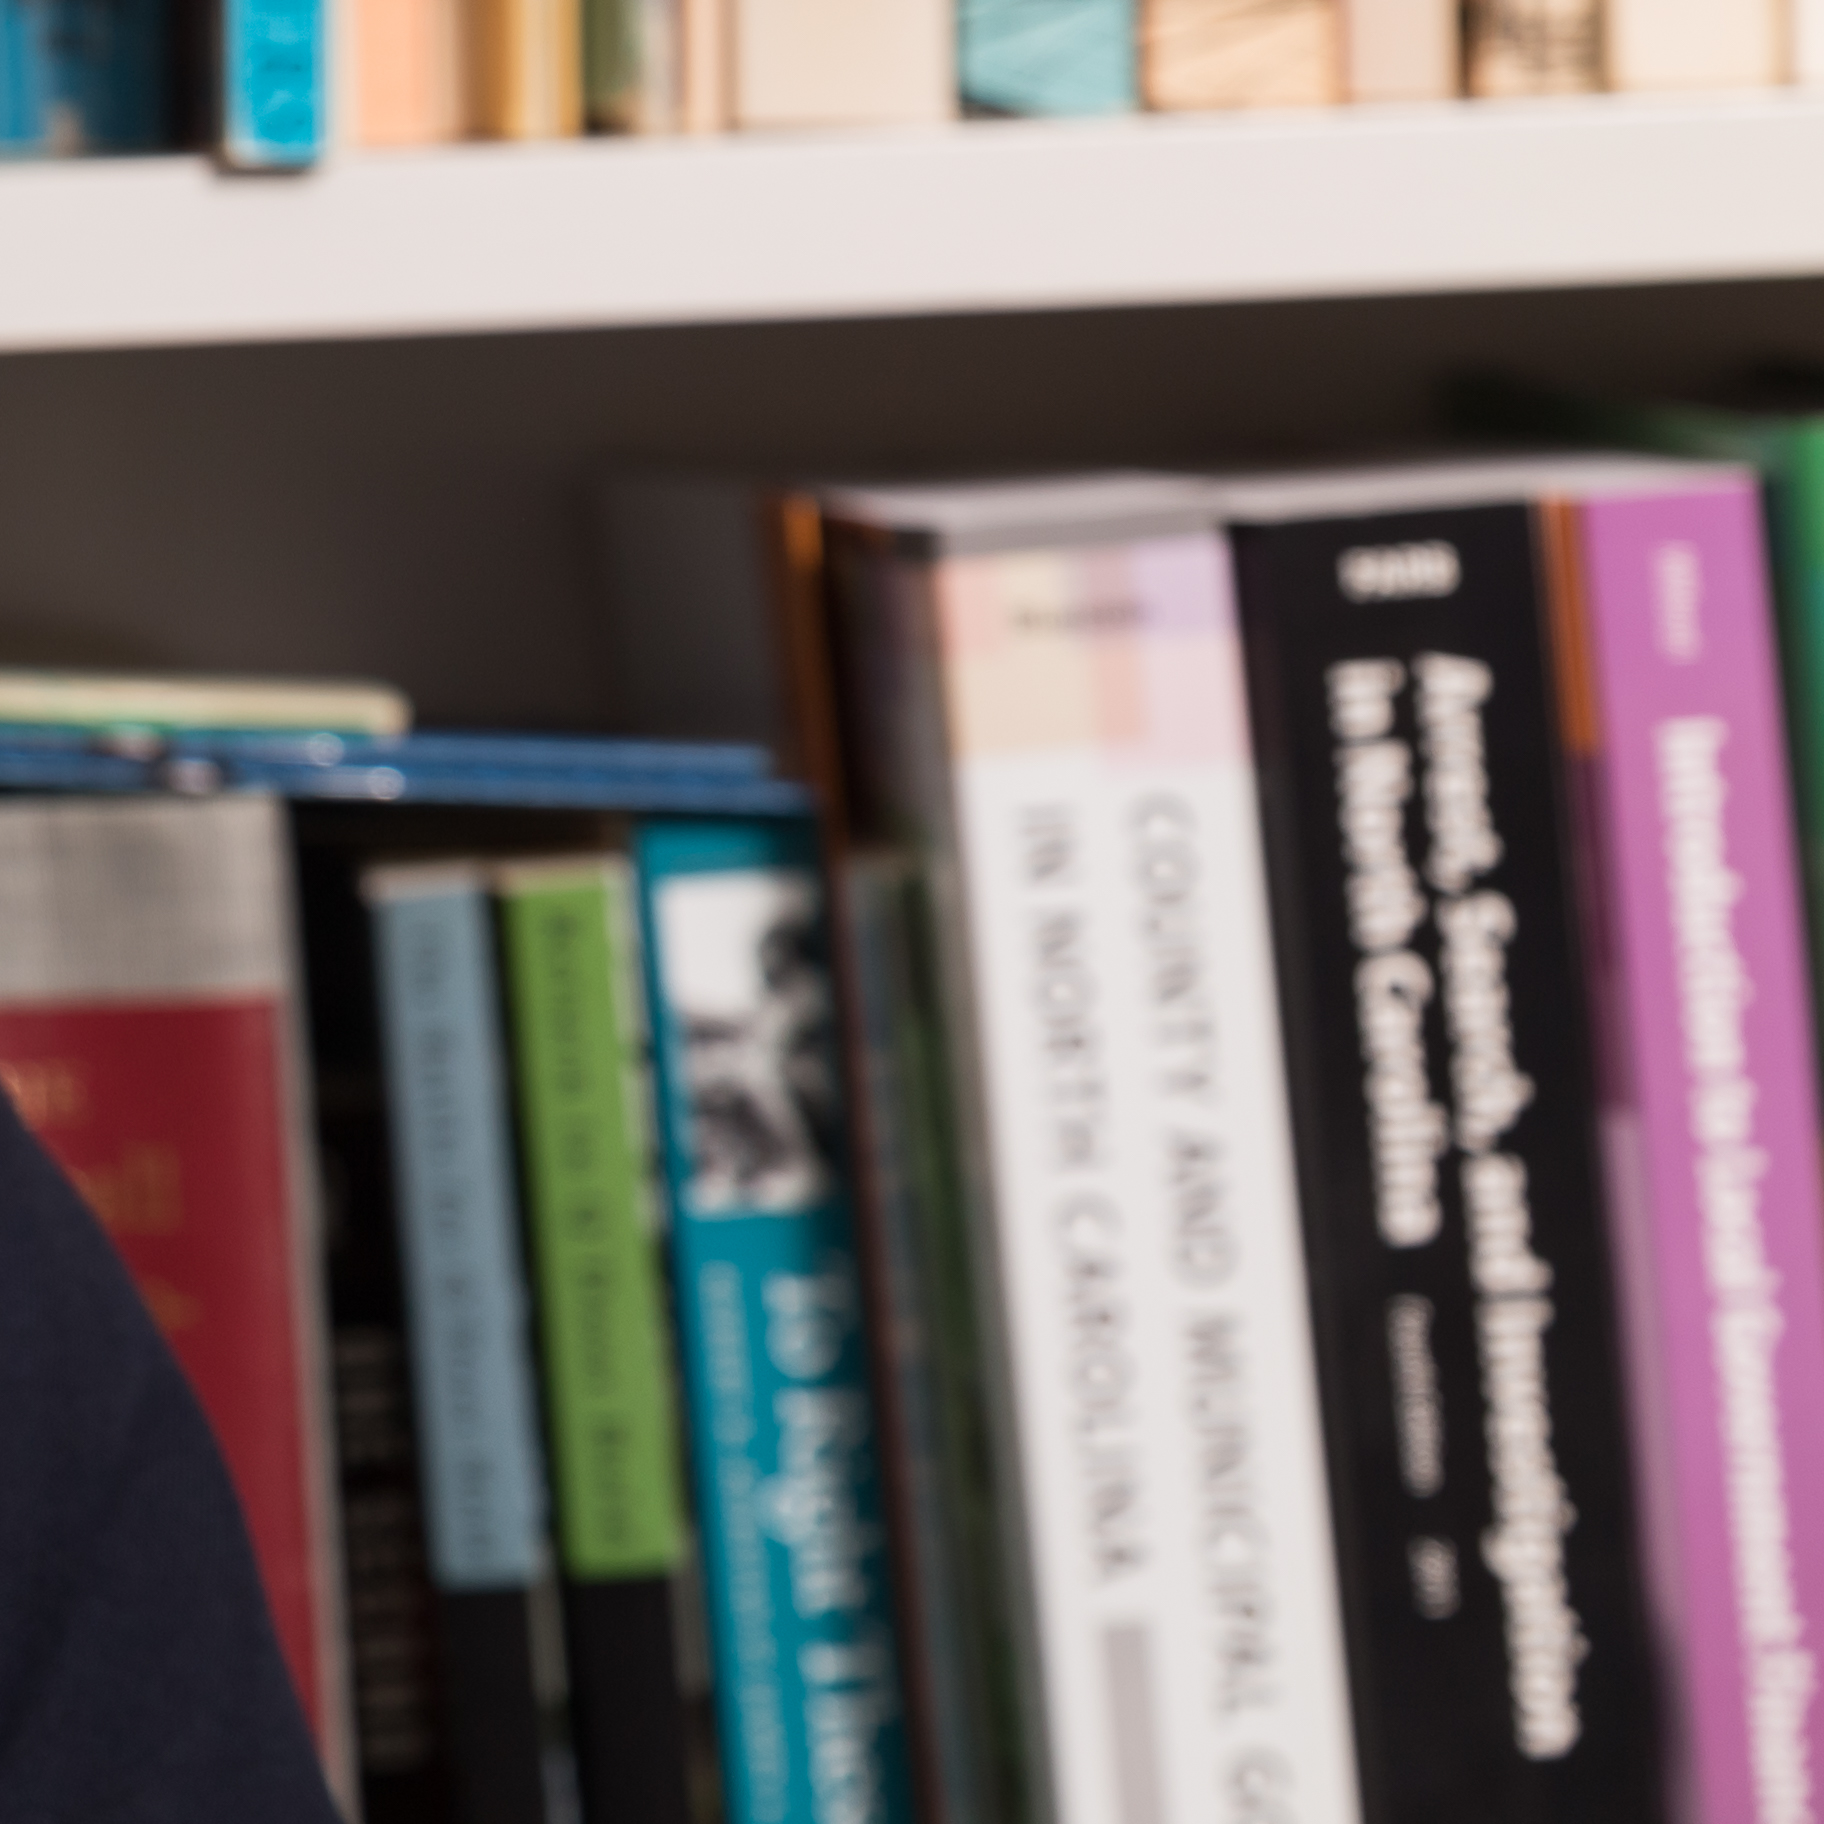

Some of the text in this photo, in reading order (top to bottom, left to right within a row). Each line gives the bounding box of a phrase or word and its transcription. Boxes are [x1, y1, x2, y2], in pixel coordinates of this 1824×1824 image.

[1122, 791, 1225, 1103] COUNTY
[1320, 649, 1455, 1251] in North Carolina
[1655, 713, 1757, 1078] Introduction
[1009, 803, 1152, 1589] IN NORTH CAROLINA
[1159, 1133, 1239, 1284] AND
[1459, 1146, 1557, 1298] and
[1682, 1071, 1759, 1149] to
[1692, 1149, 1775, 1299] Local
[1172, 1303, 1287, 1729] MUNICIPAL
[1475, 1291, 1595, 1764] Investigation
[1705, 1293, 1805, 1643] Government
